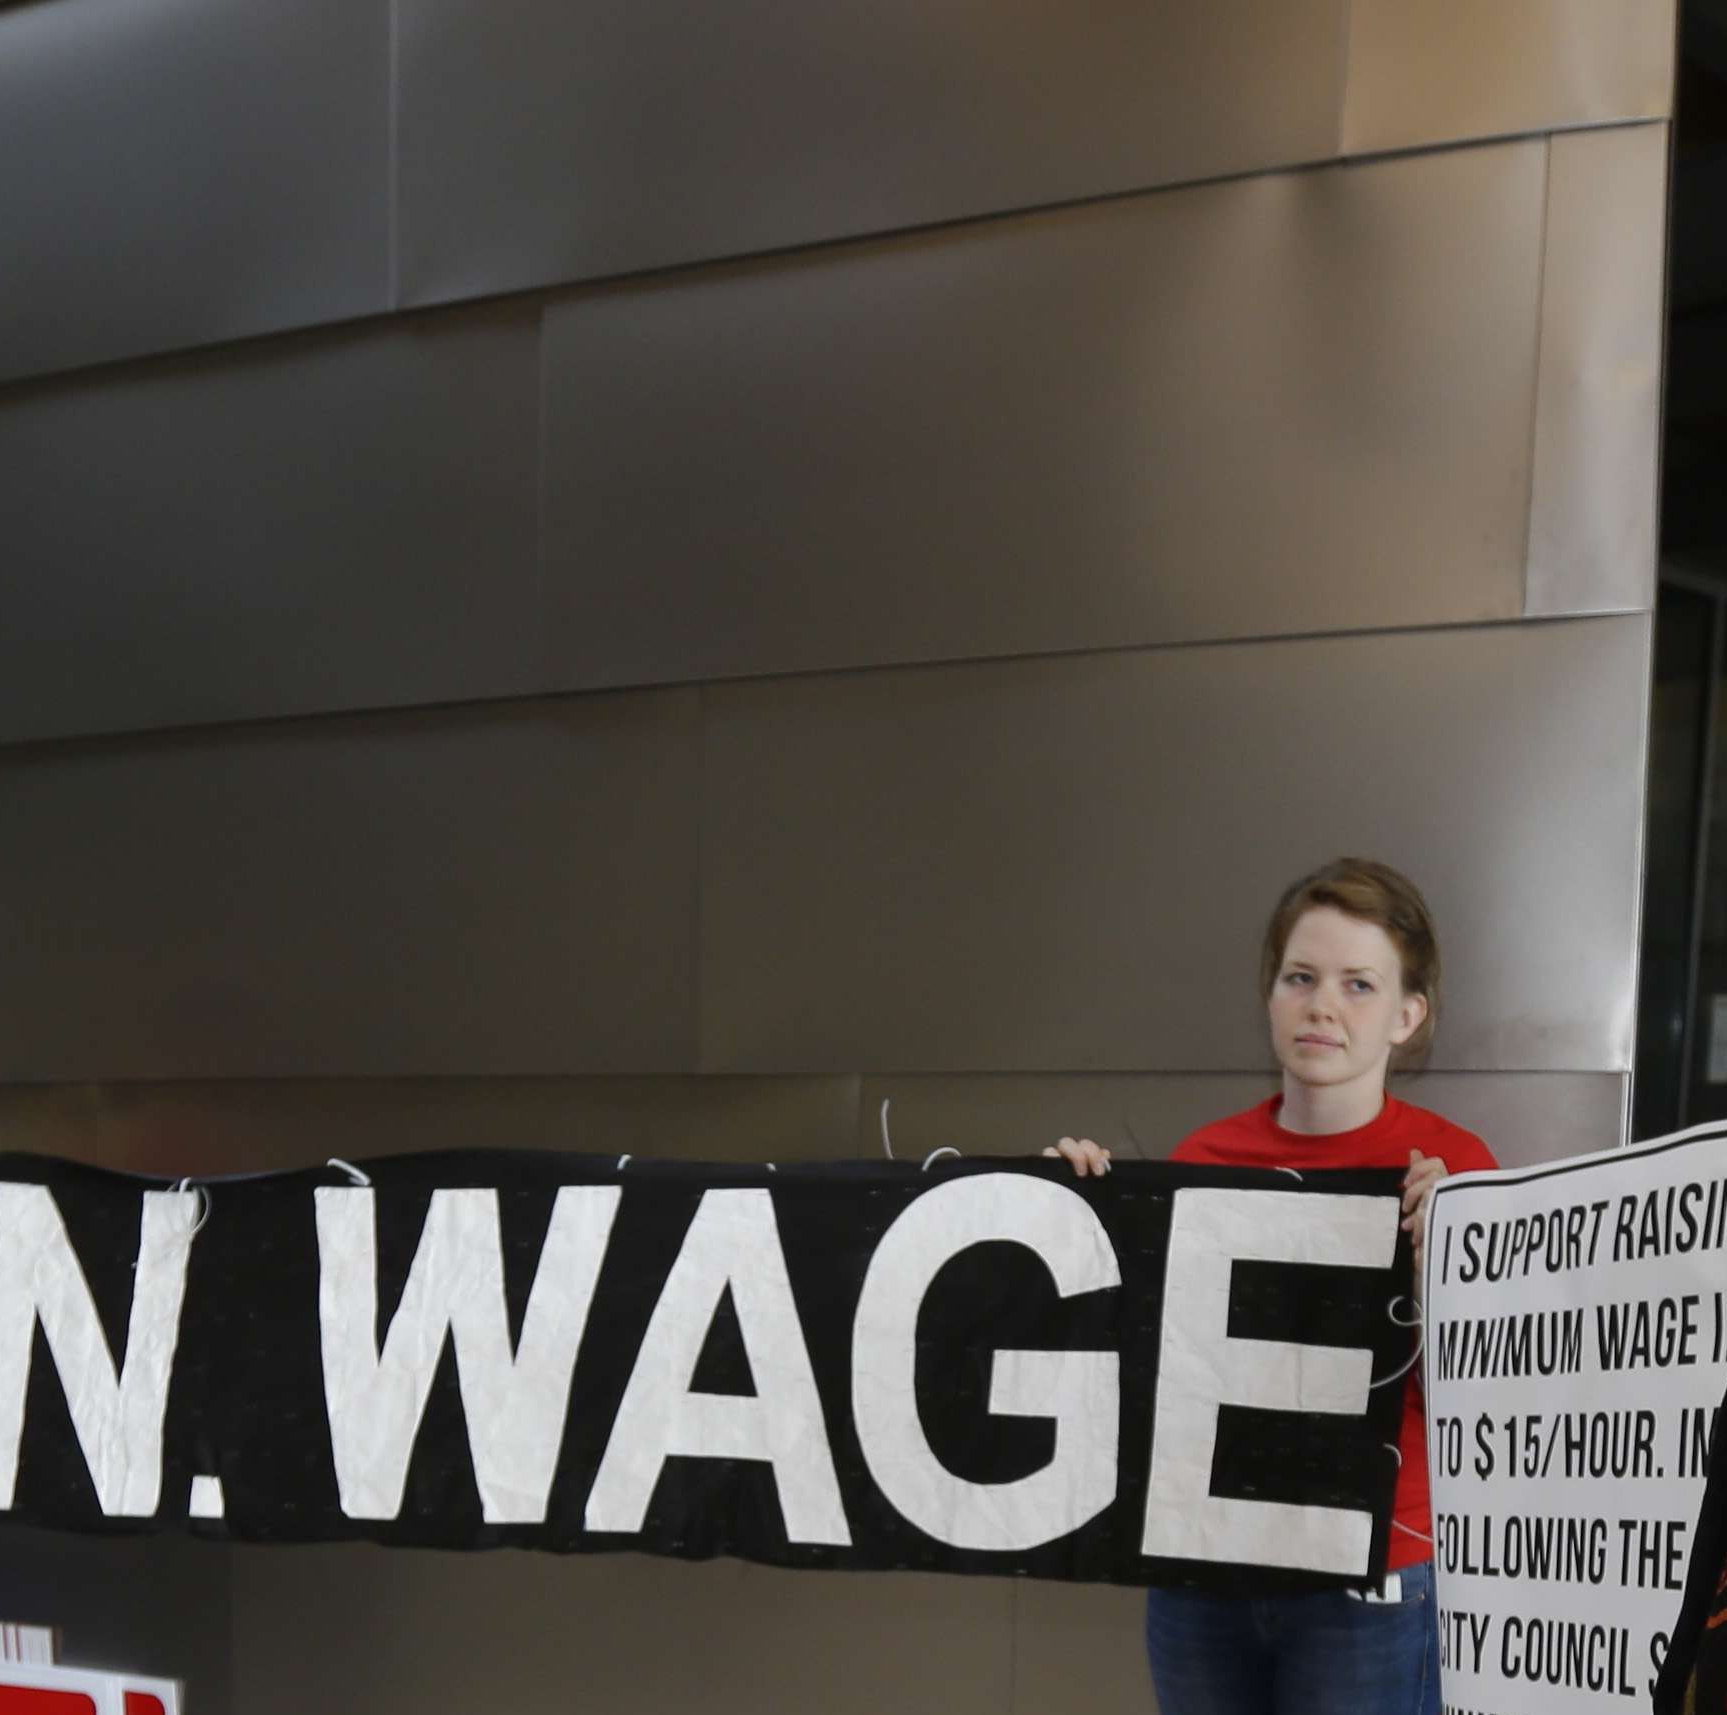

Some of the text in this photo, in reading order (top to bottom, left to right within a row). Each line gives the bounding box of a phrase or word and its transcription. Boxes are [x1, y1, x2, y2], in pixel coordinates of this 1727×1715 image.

[1441, 1225, 1453, 1285] I
[1459, 1200, 1609, 1284] SUPPORT
[314, 1172, 1400, 1577] WAGE
[1438, 1308, 1583, 1381] MINIMUM
[1596, 1295, 1699, 1371] WAGE
[1437, 1417, 1463, 1477] TO
[1438, 1513, 1687, 1590] FOLLOWING THE
[1440, 1608, 1490, 1674] CITY
[1500, 1616, 1636, 1697] COUNCIL
